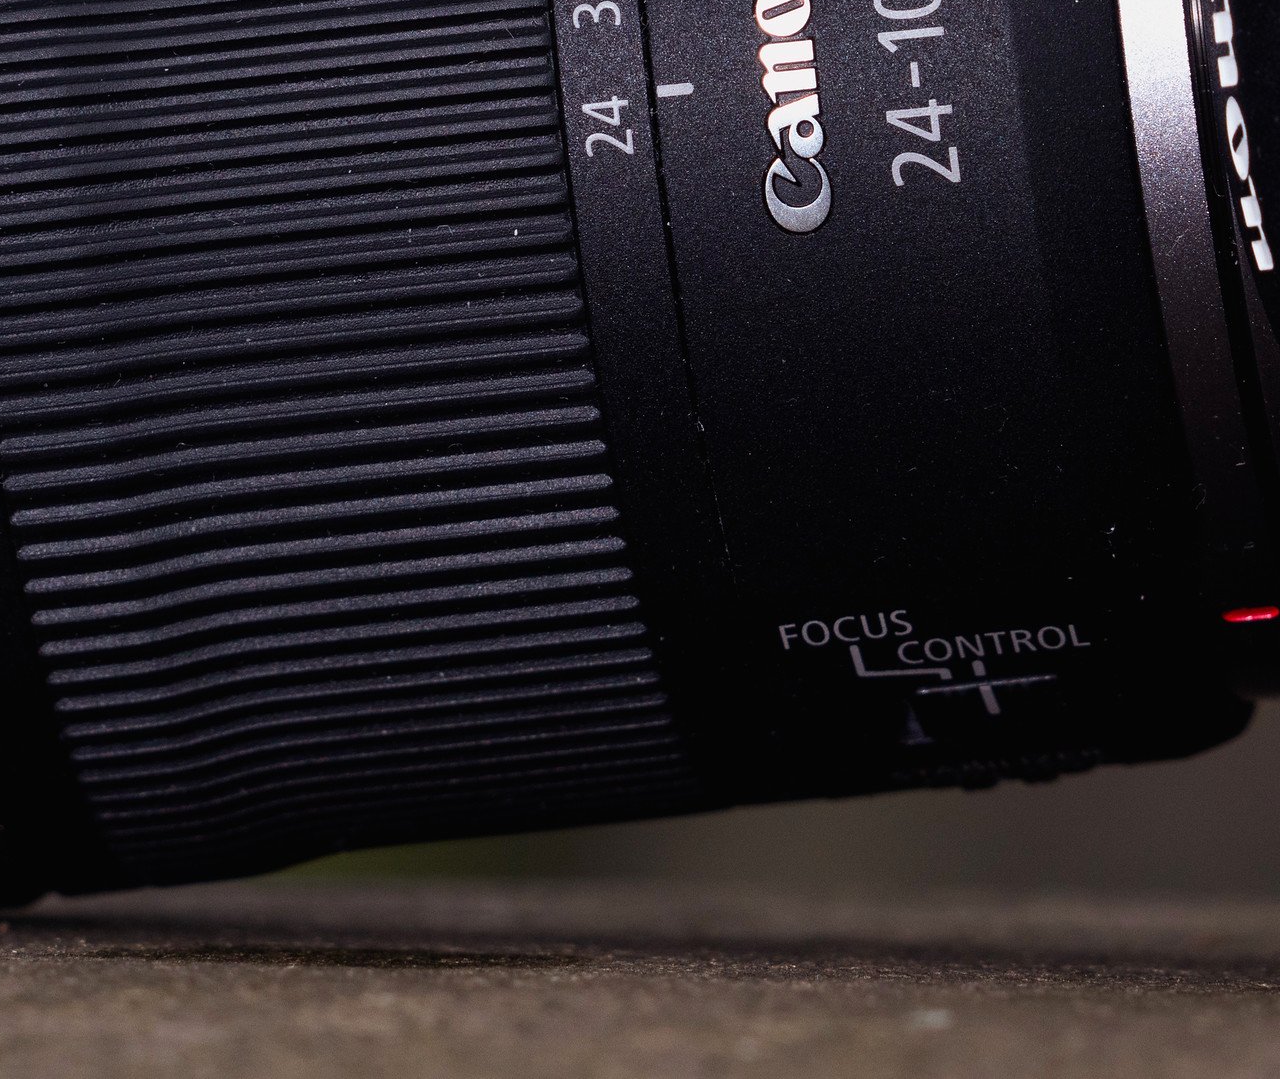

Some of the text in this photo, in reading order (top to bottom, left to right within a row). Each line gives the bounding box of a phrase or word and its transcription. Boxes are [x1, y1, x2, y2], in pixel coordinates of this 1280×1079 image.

[581, 95, 635, 158] 24
[778, 610, 913, 651] FOCUS
[897, 624, 1090, 664] CONTROL
